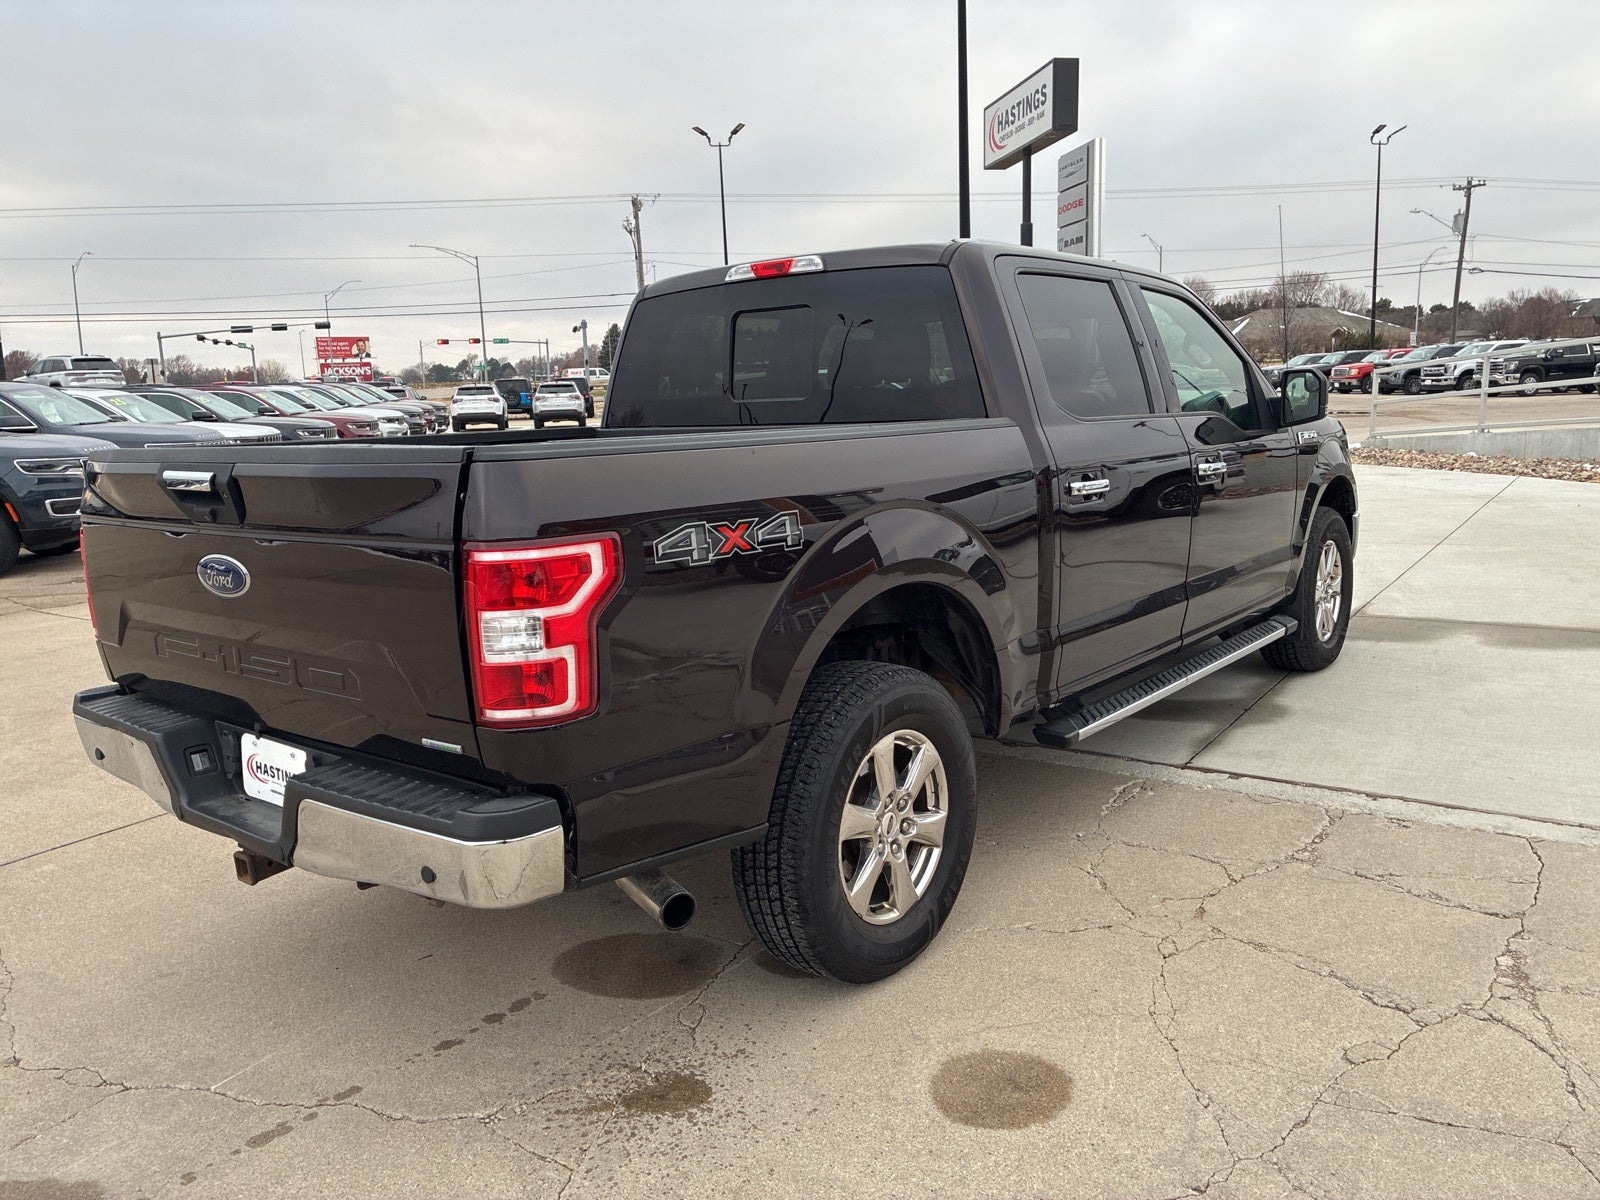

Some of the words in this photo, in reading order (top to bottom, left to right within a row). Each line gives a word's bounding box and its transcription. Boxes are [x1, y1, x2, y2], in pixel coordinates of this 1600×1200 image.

[997, 83, 1048, 135] HASTINGS
[1059, 157, 1084, 173] CHRYSLER
[1058, 198, 1084, 216] DODGE
[1064, 235, 1084, 249] RAM
[322, 366, 372, 376] JACKSON'S
[205, 562, 234, 590] Ford
[155, 631, 361, 701] F-150
[255, 760, 292, 784] HASTIN
